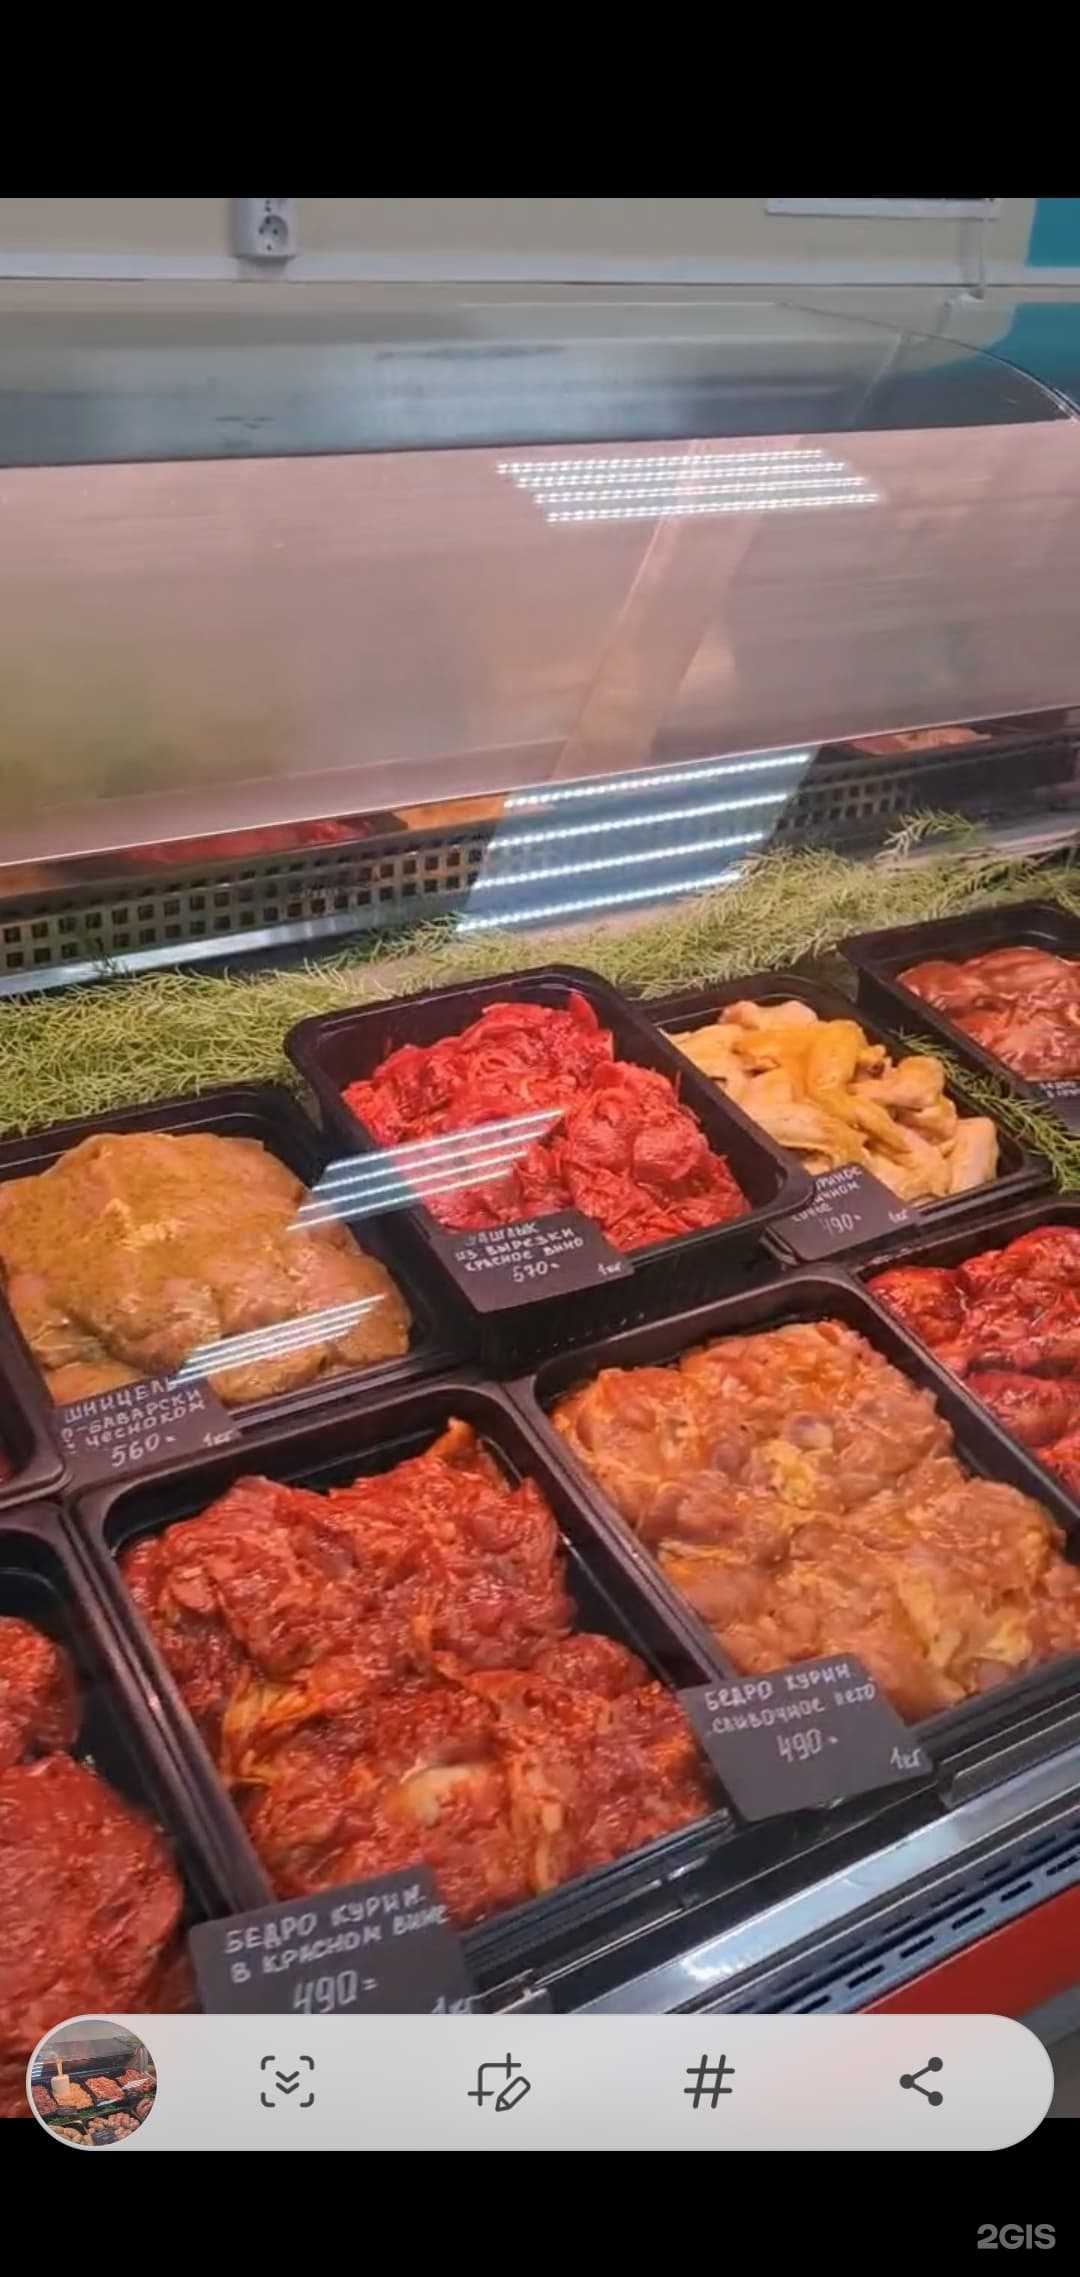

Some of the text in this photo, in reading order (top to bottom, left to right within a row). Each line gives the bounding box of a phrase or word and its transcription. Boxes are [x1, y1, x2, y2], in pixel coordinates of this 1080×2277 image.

[455, 1227, 575, 1262] ИЗ ВЫРЕЗКИ
[464, 1236, 584, 1272] КРАСНОЕ ВИНО
[86, 1401, 206, 1448] ЧЕСНОКОМ
[704, 1680, 774, 1712] БЕДРО
[711, 1697, 826, 1735] СЛИВОЧНОЕ
[225, 1913, 318, 1954] БЕДРО
[230, 1904, 449, 1984] В КРАСНОМ ВИНЕ
